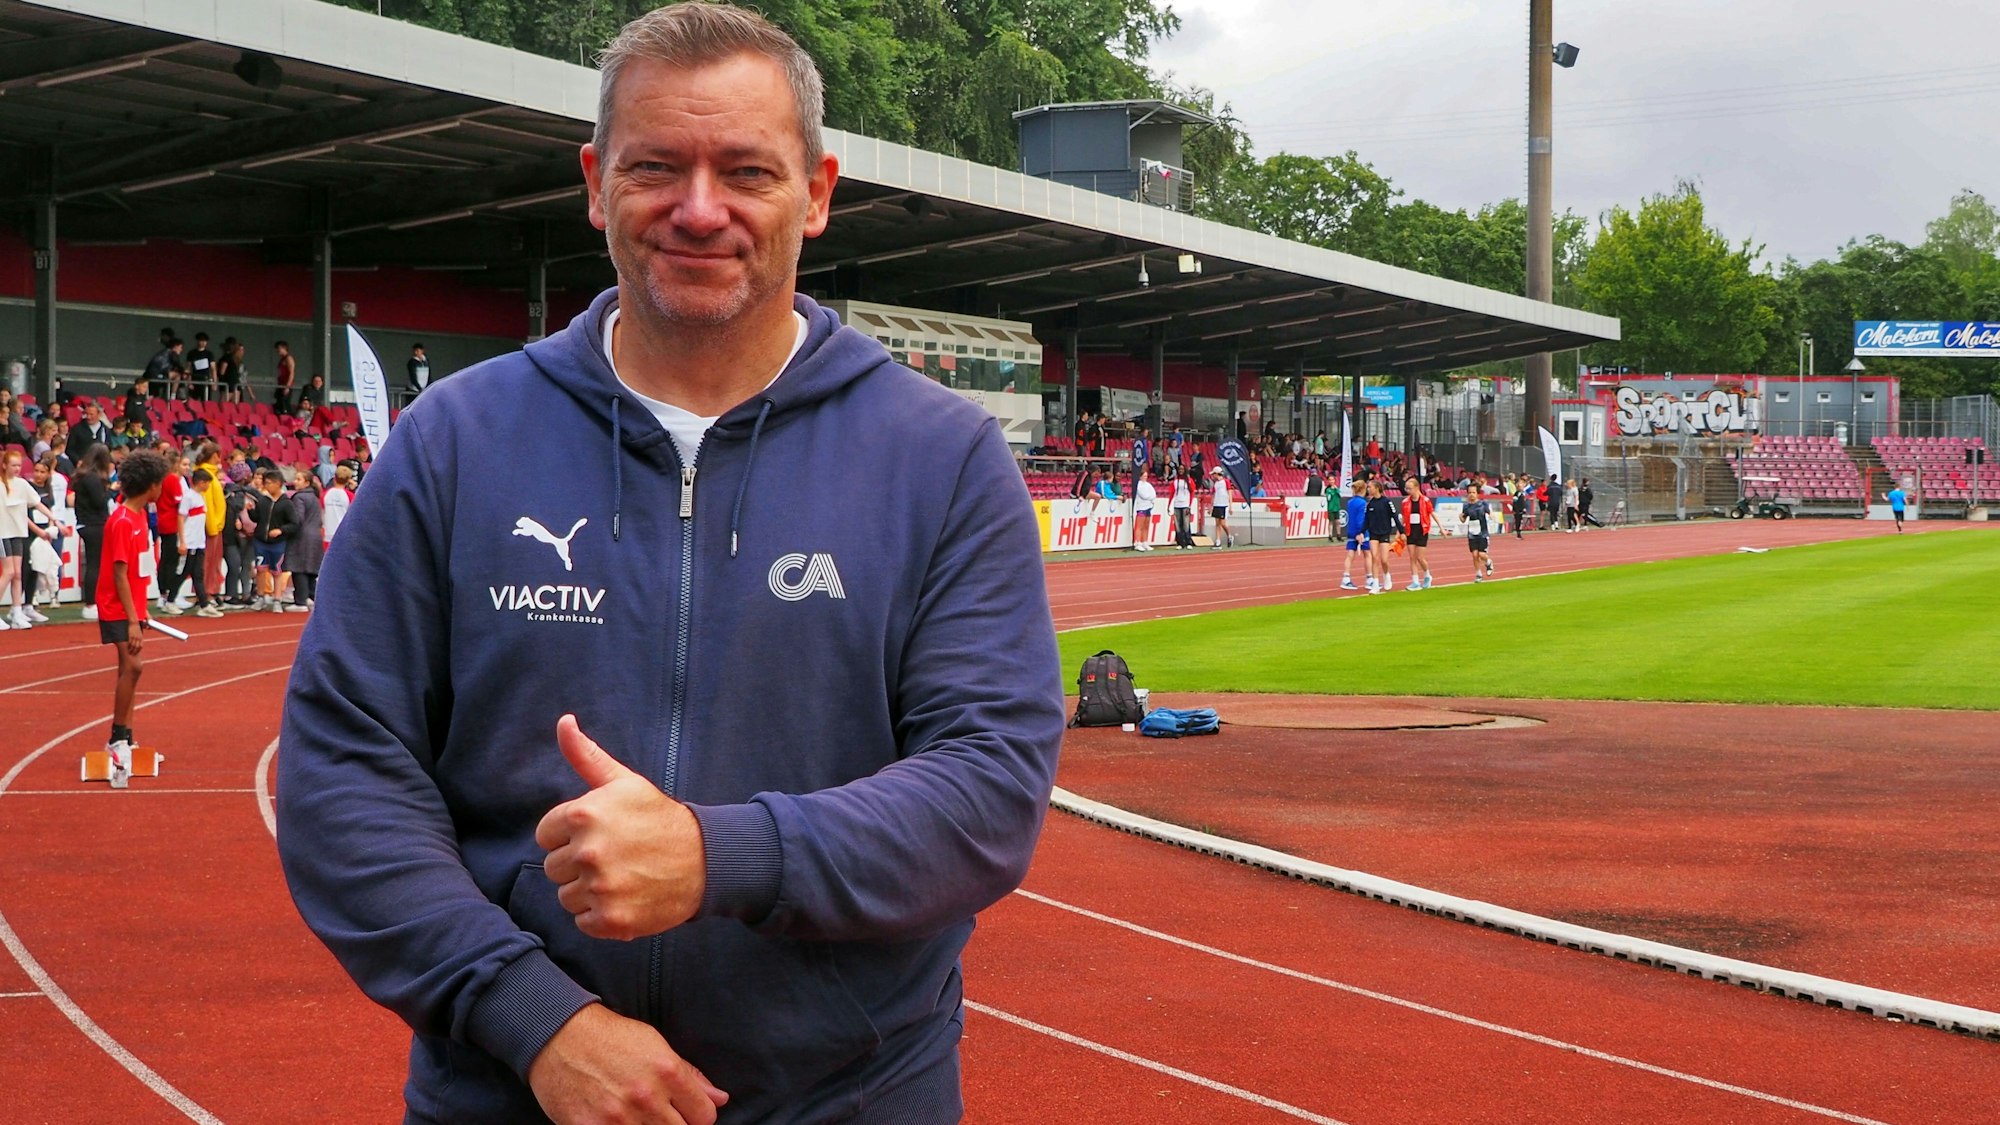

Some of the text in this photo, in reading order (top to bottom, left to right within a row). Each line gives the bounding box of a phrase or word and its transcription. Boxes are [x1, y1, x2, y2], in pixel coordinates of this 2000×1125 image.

[1857, 321, 1940, 347] Malzkorn
[1058, 516, 1088, 546] HIT
[1094, 516, 1123, 544] HIT
[768, 553, 846, 602] CA
[488, 585, 606, 612] VIACTIV
[527, 612, 604, 625] Krankenkasse
